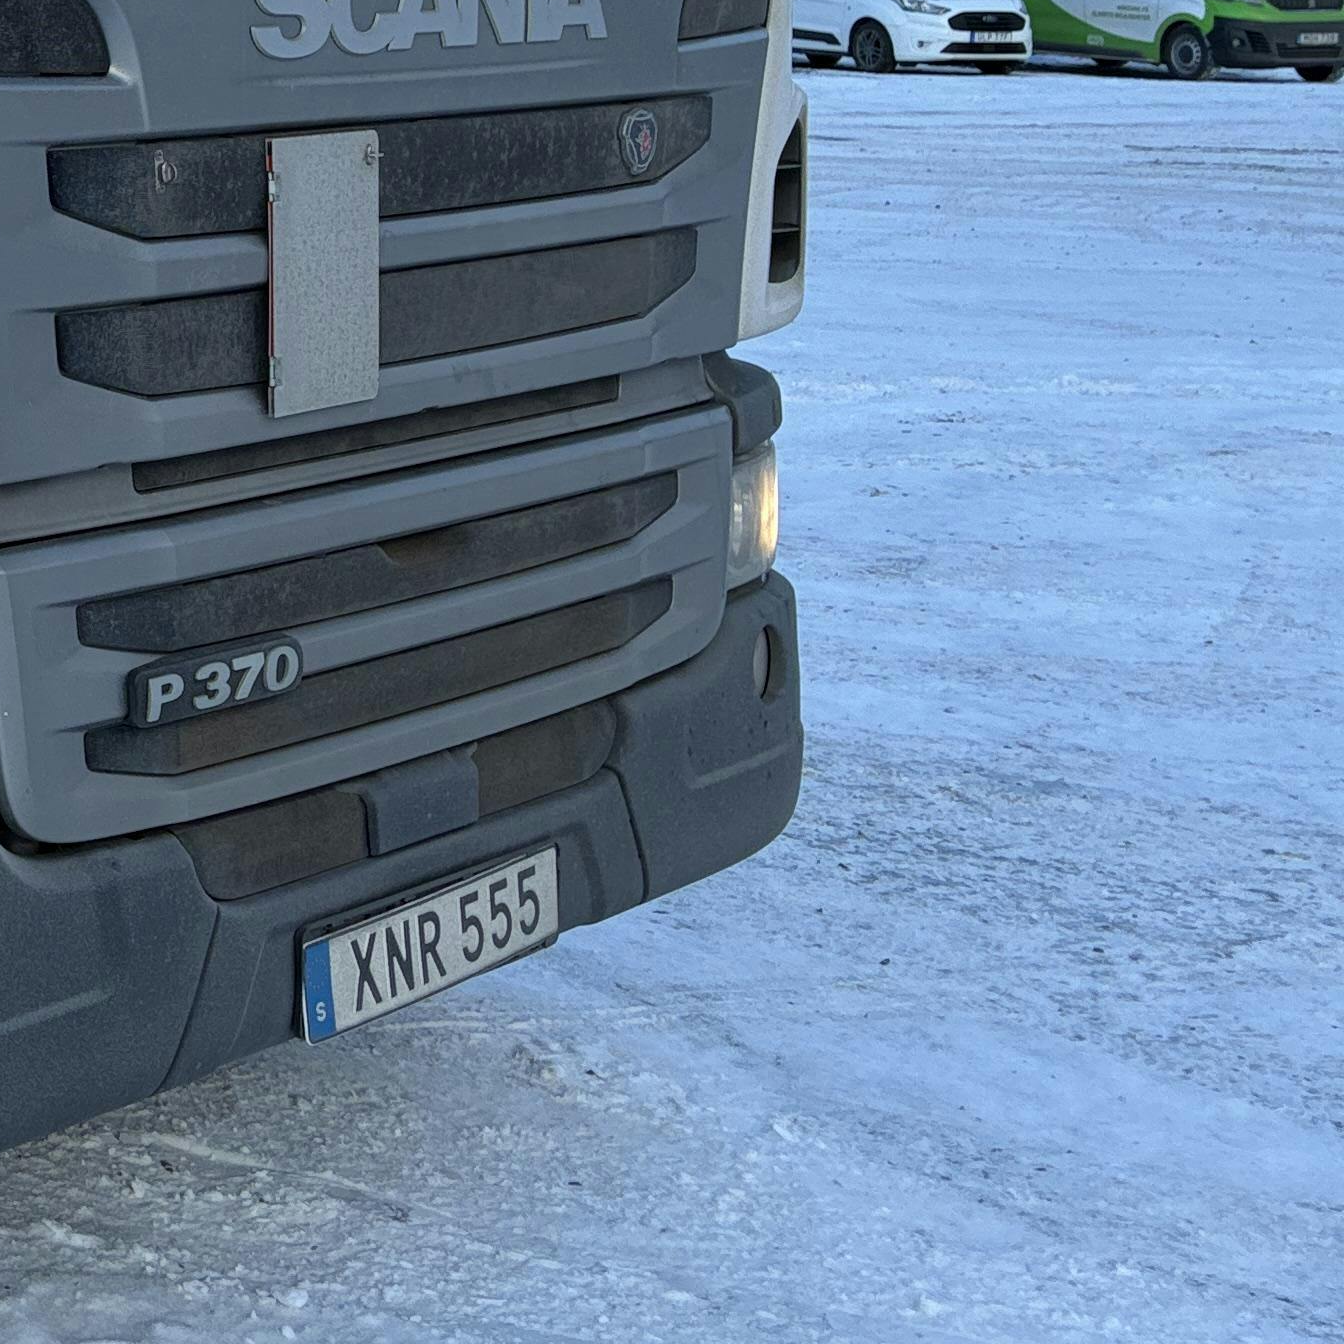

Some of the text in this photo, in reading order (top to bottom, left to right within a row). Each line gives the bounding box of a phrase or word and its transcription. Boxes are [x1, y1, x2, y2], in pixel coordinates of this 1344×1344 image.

[146, 645, 300, 723] P 370
[350, 864, 541, 1013] XNR 555
[315, 1001, 326, 1022] S
